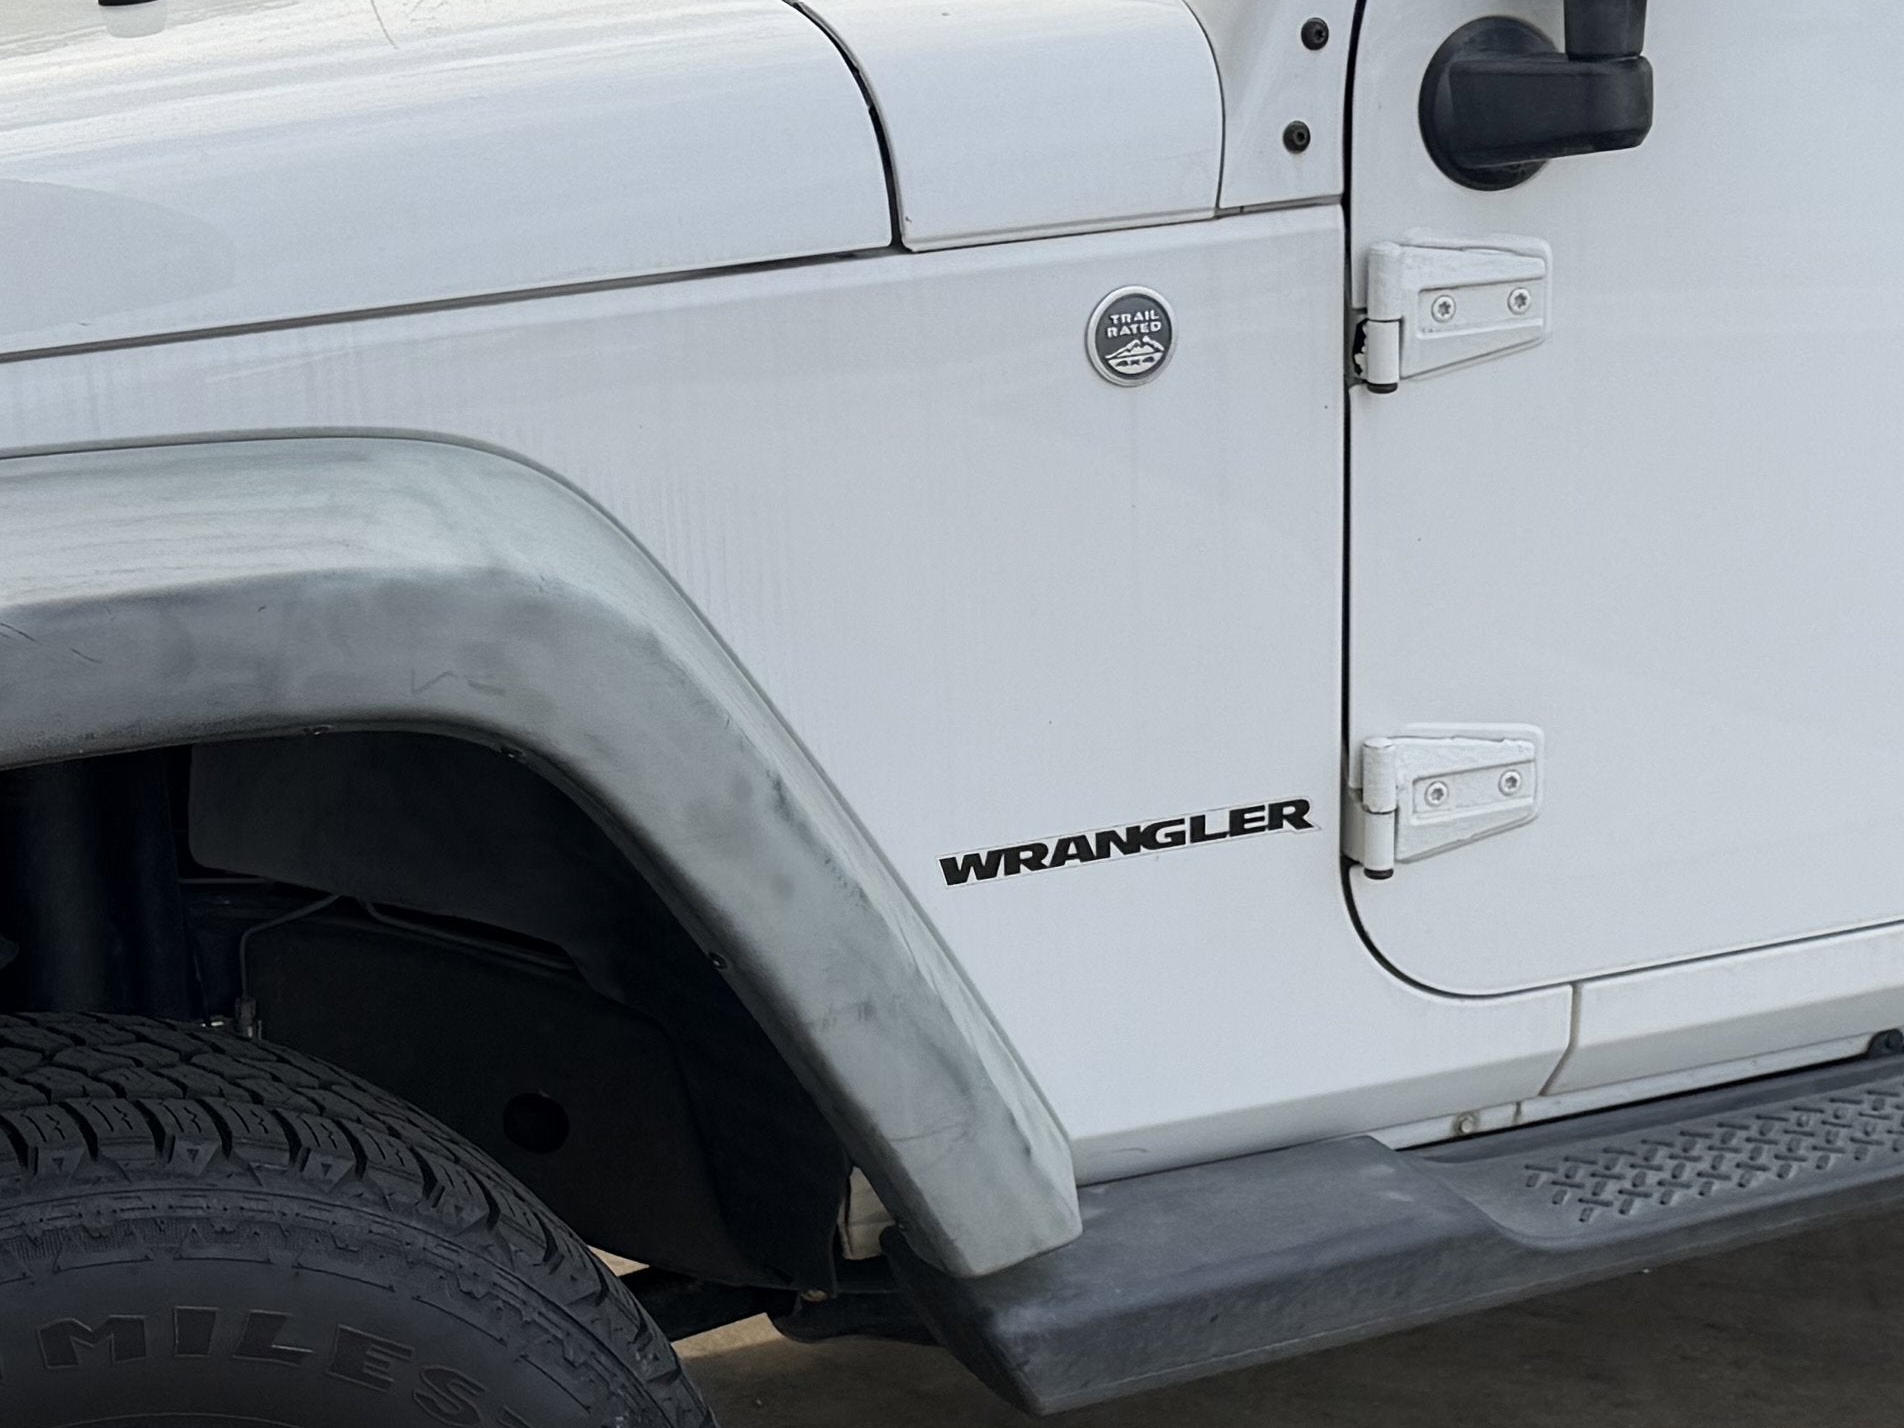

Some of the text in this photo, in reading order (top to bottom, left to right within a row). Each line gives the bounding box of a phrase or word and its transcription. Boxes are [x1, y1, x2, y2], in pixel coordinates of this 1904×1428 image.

[1110, 309, 1160, 324] TRAIL
[1107, 321, 1162, 338] RATED
[939, 798, 1315, 887] WRANGLER
